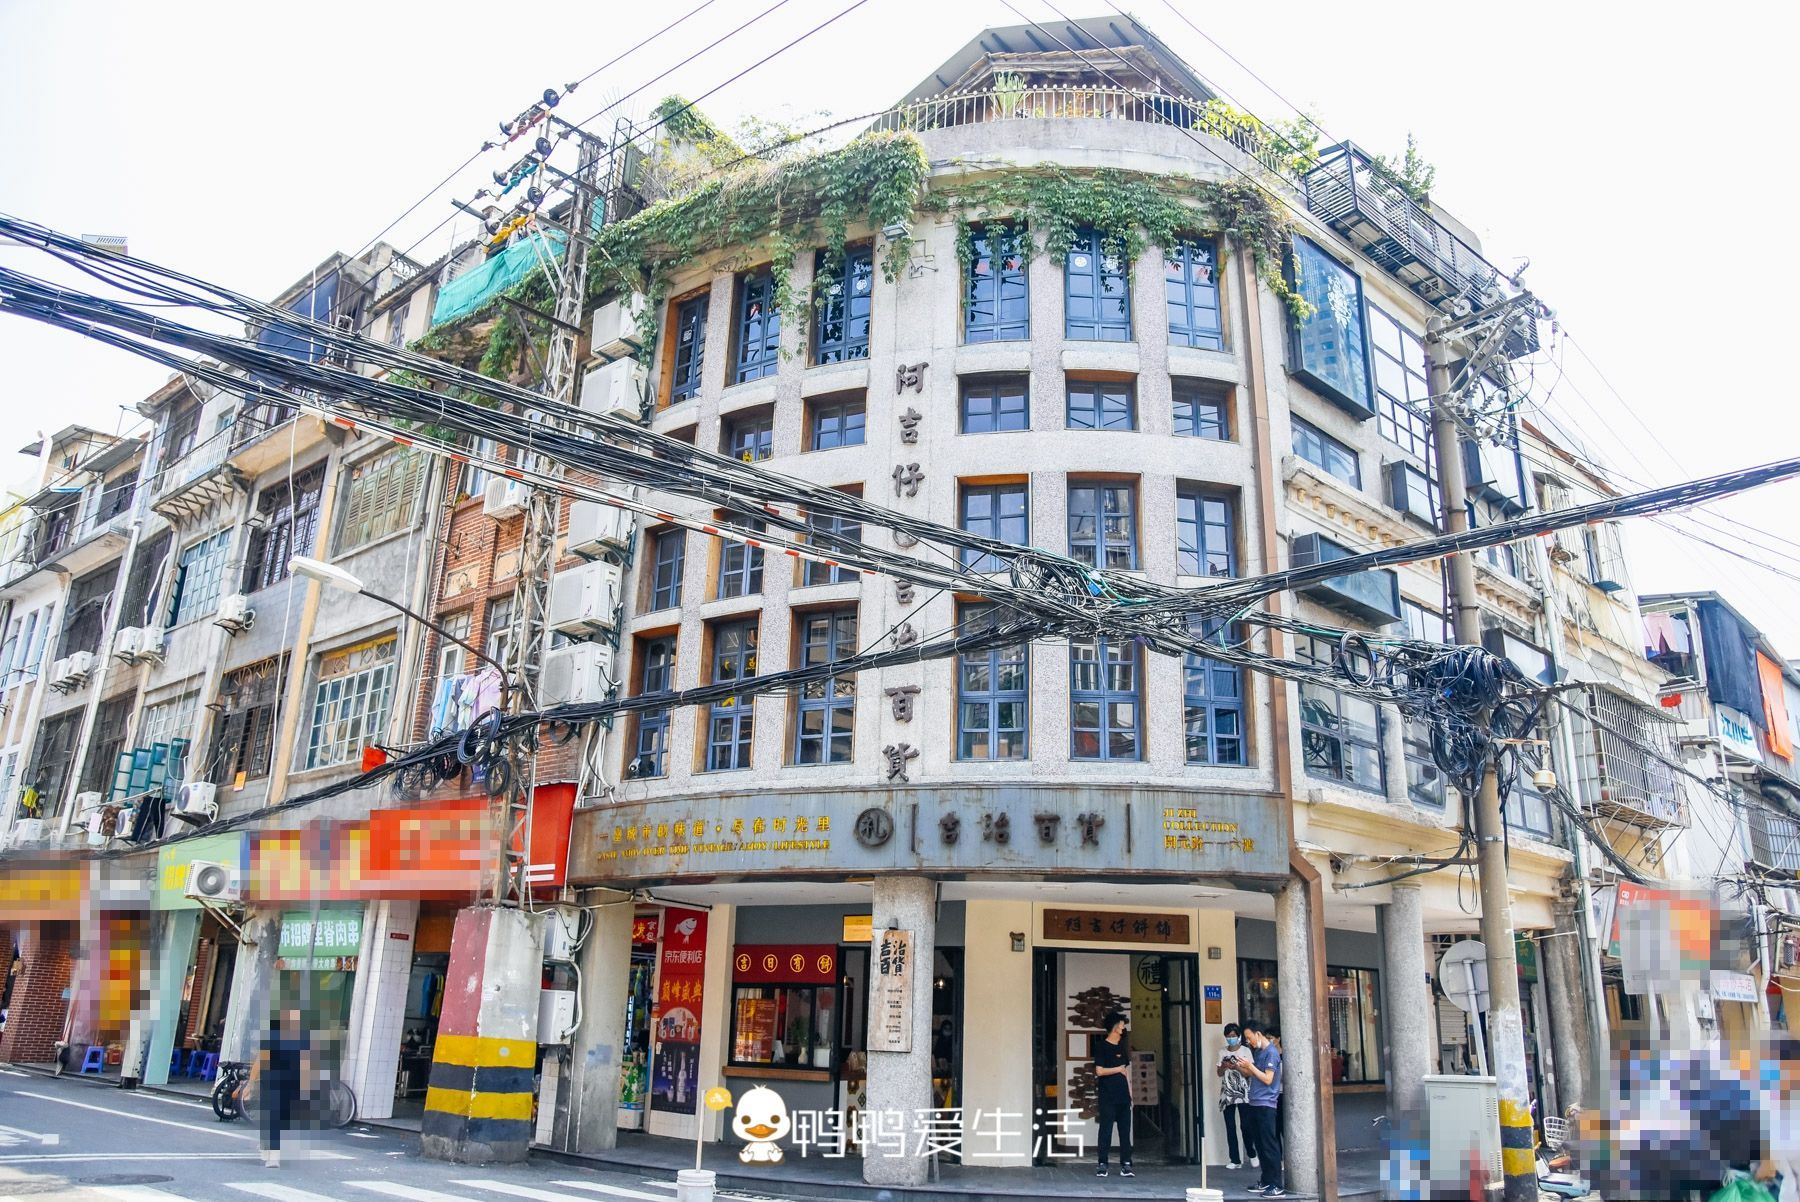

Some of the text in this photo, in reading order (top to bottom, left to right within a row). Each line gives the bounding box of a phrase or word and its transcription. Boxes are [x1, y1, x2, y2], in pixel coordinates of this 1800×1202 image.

[891, 361, 929, 498] 阿吉仔
[938, 811, 1105, 847] 吉治百貨
[1163, 821, 1239, 833] COLLECTION
[664, 950, 703, 964] 京东便利店
